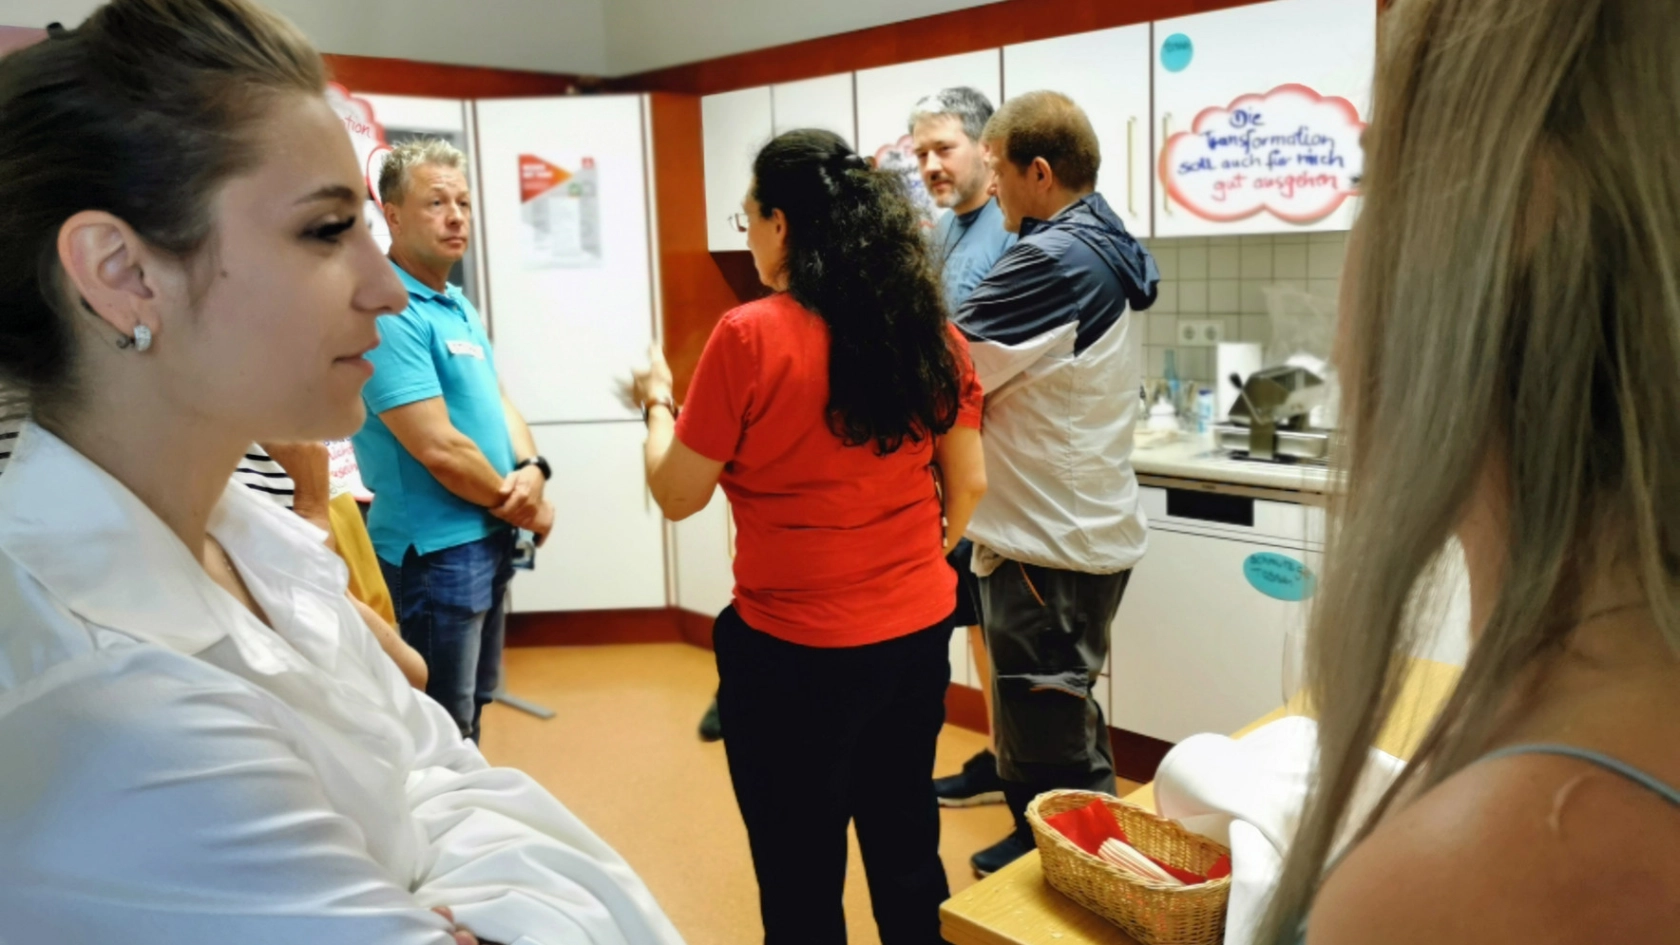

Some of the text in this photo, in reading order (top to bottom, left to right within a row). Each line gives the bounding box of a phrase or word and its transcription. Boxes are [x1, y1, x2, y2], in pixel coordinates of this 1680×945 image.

[1229, 107, 1264, 129] Die
[1202, 126, 1335, 154] Transformation
[1177, 148, 1345, 175] soll auch für mich
[1211, 173, 1247, 201] gut
